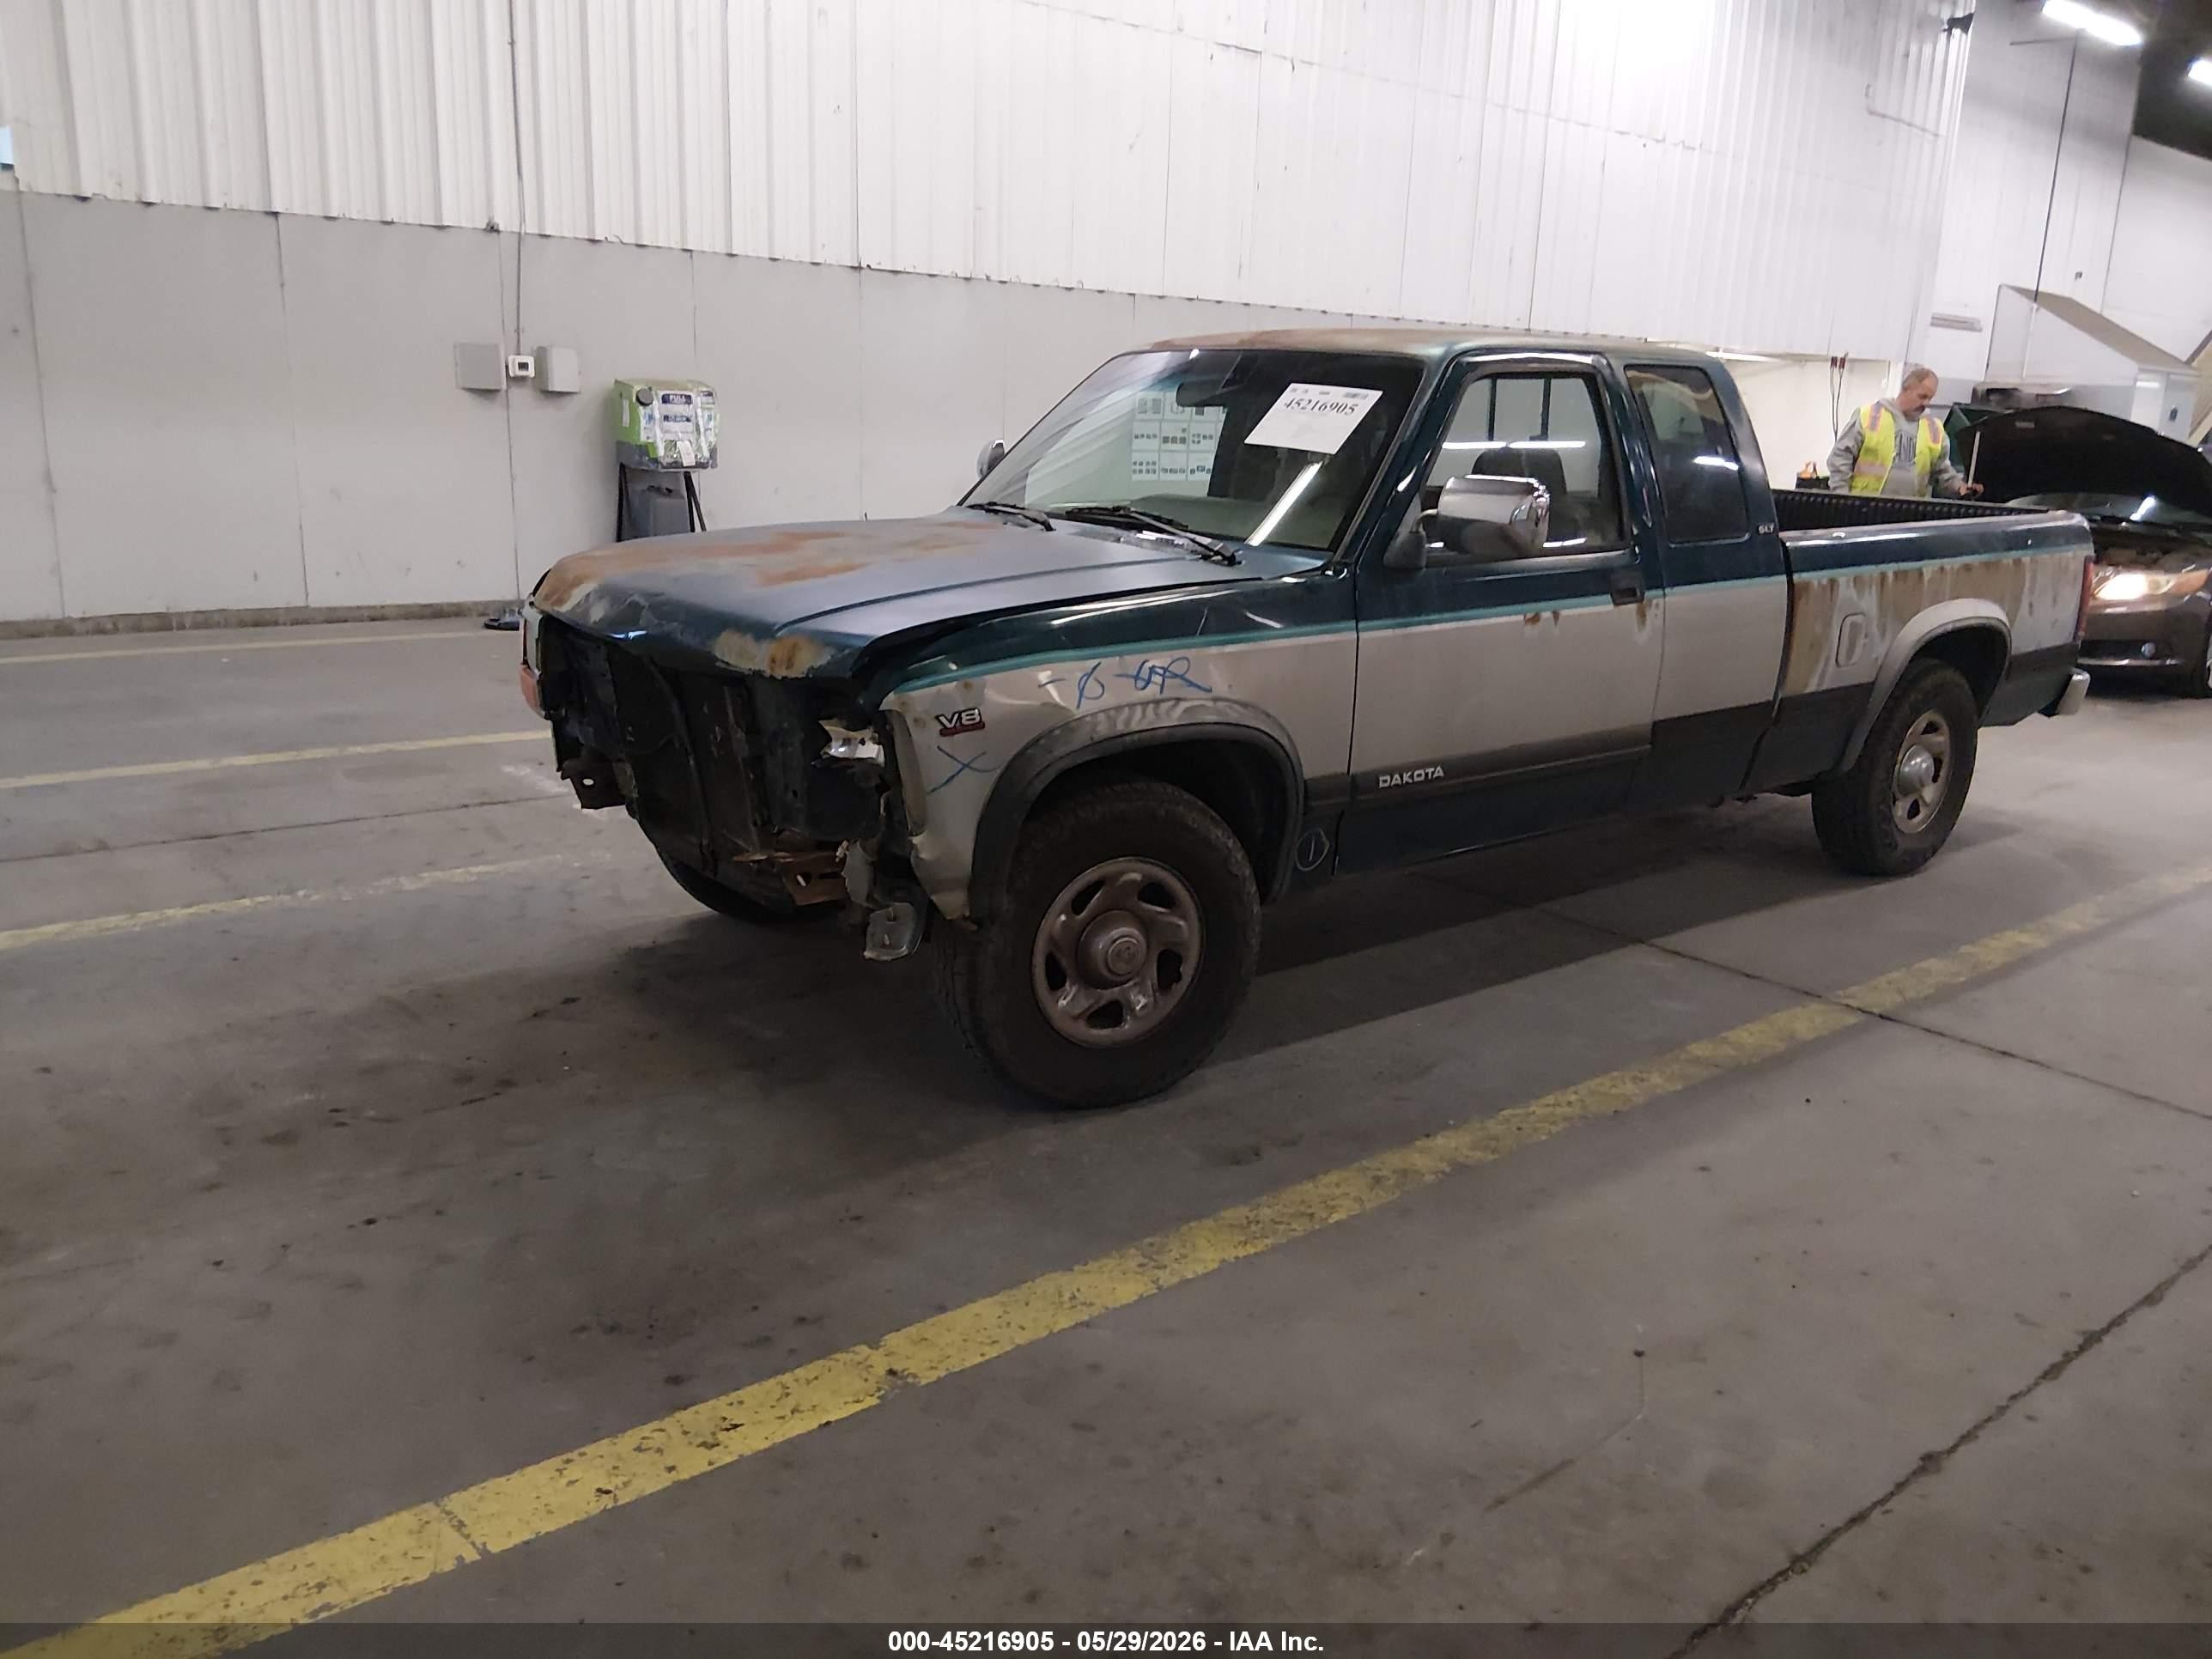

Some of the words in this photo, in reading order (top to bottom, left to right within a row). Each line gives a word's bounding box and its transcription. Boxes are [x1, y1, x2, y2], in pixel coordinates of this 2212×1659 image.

[1284, 398, 1358, 416] 45216905
[938, 708, 981, 730] V8
[1378, 765, 1444, 788] DAKOTA
